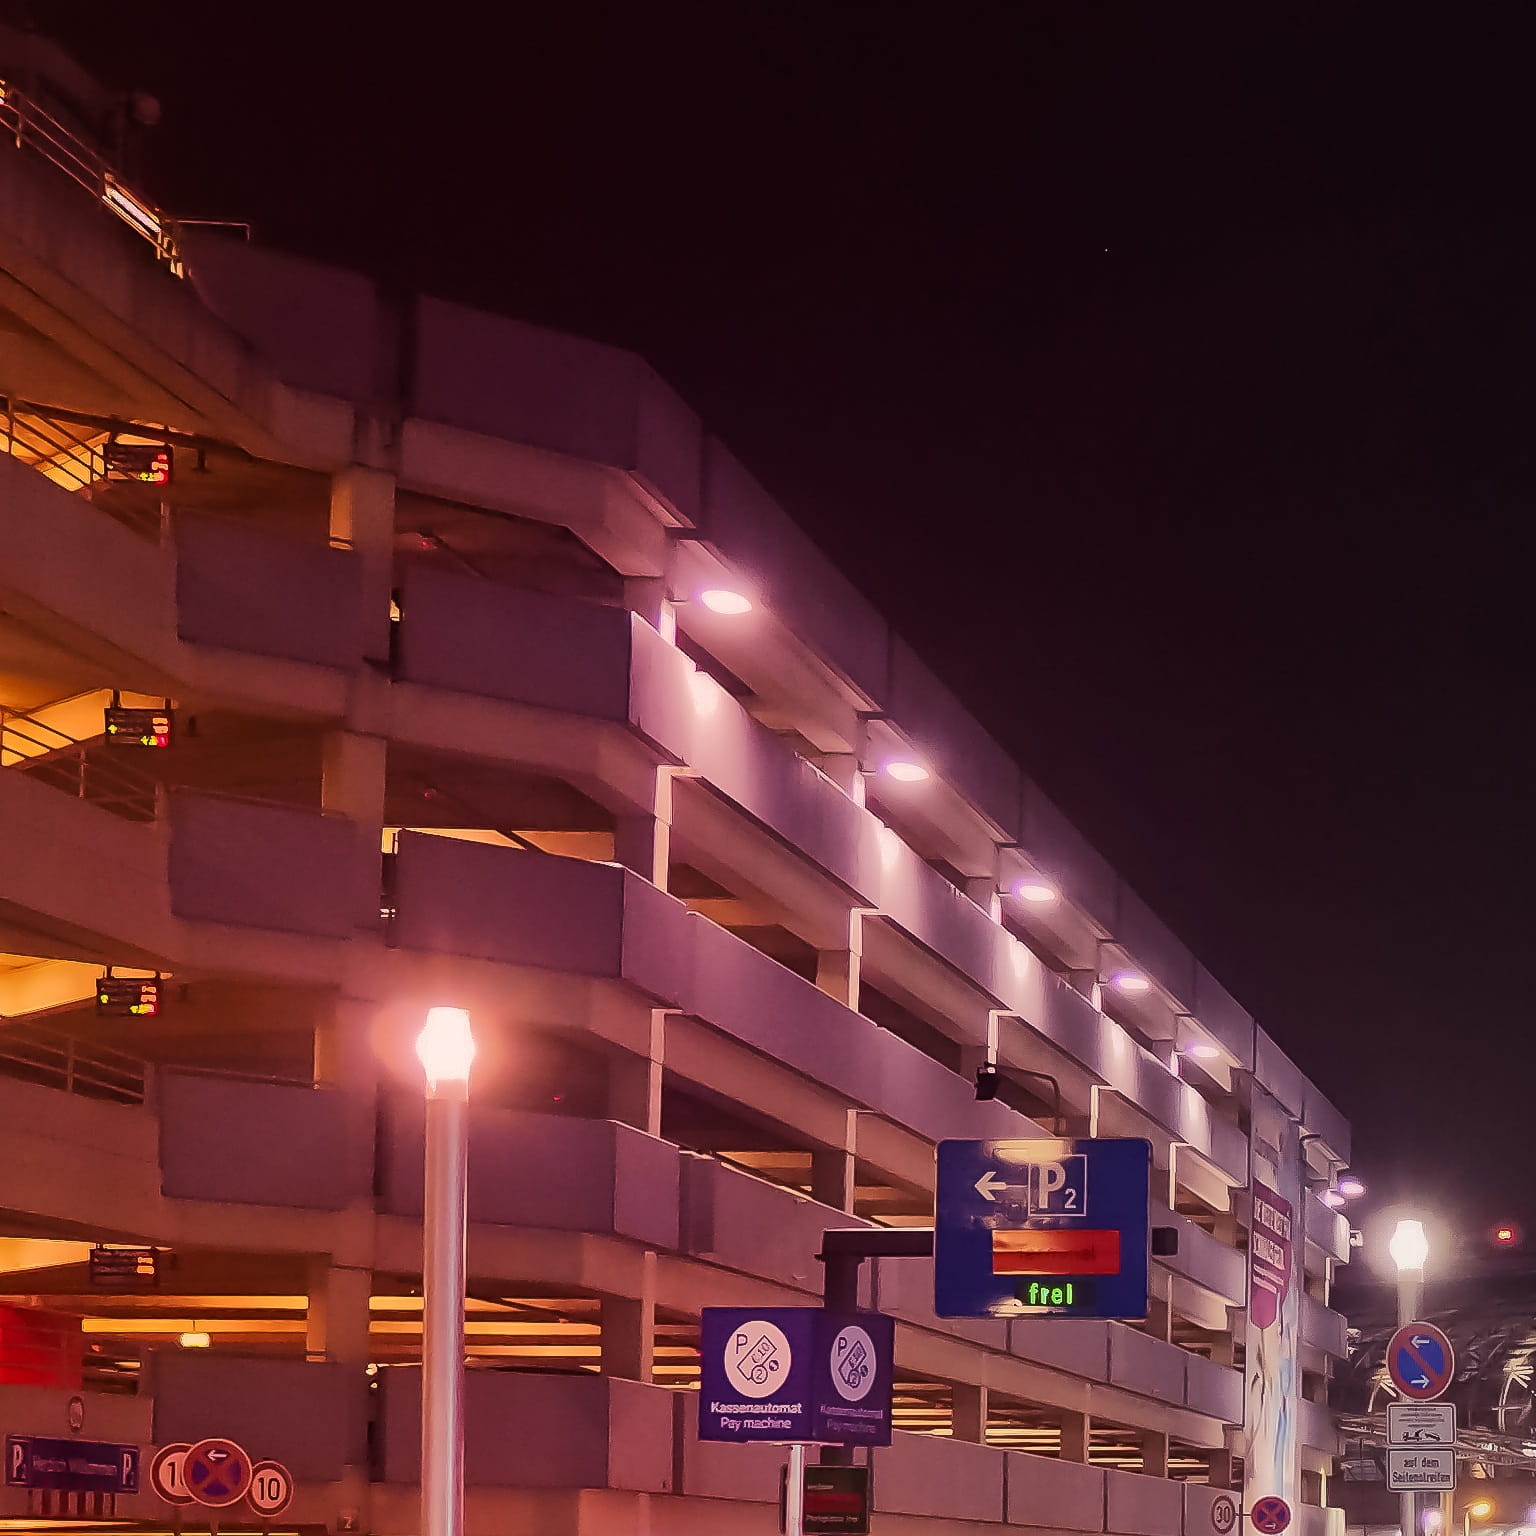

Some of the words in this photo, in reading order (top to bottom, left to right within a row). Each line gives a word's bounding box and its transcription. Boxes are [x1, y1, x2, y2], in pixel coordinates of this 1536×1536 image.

[1037, 1162, 1077, 1209] P2
[711, 1402, 803, 1414] Kassenautomat
[720, 1417, 741, 1431] Pay
[744, 1417, 792, 1429] machine
[1422, 1457, 1439, 1467] dem
[258, 1477, 280, 1501] 10
[1216, 1505, 1230, 1524] 30
